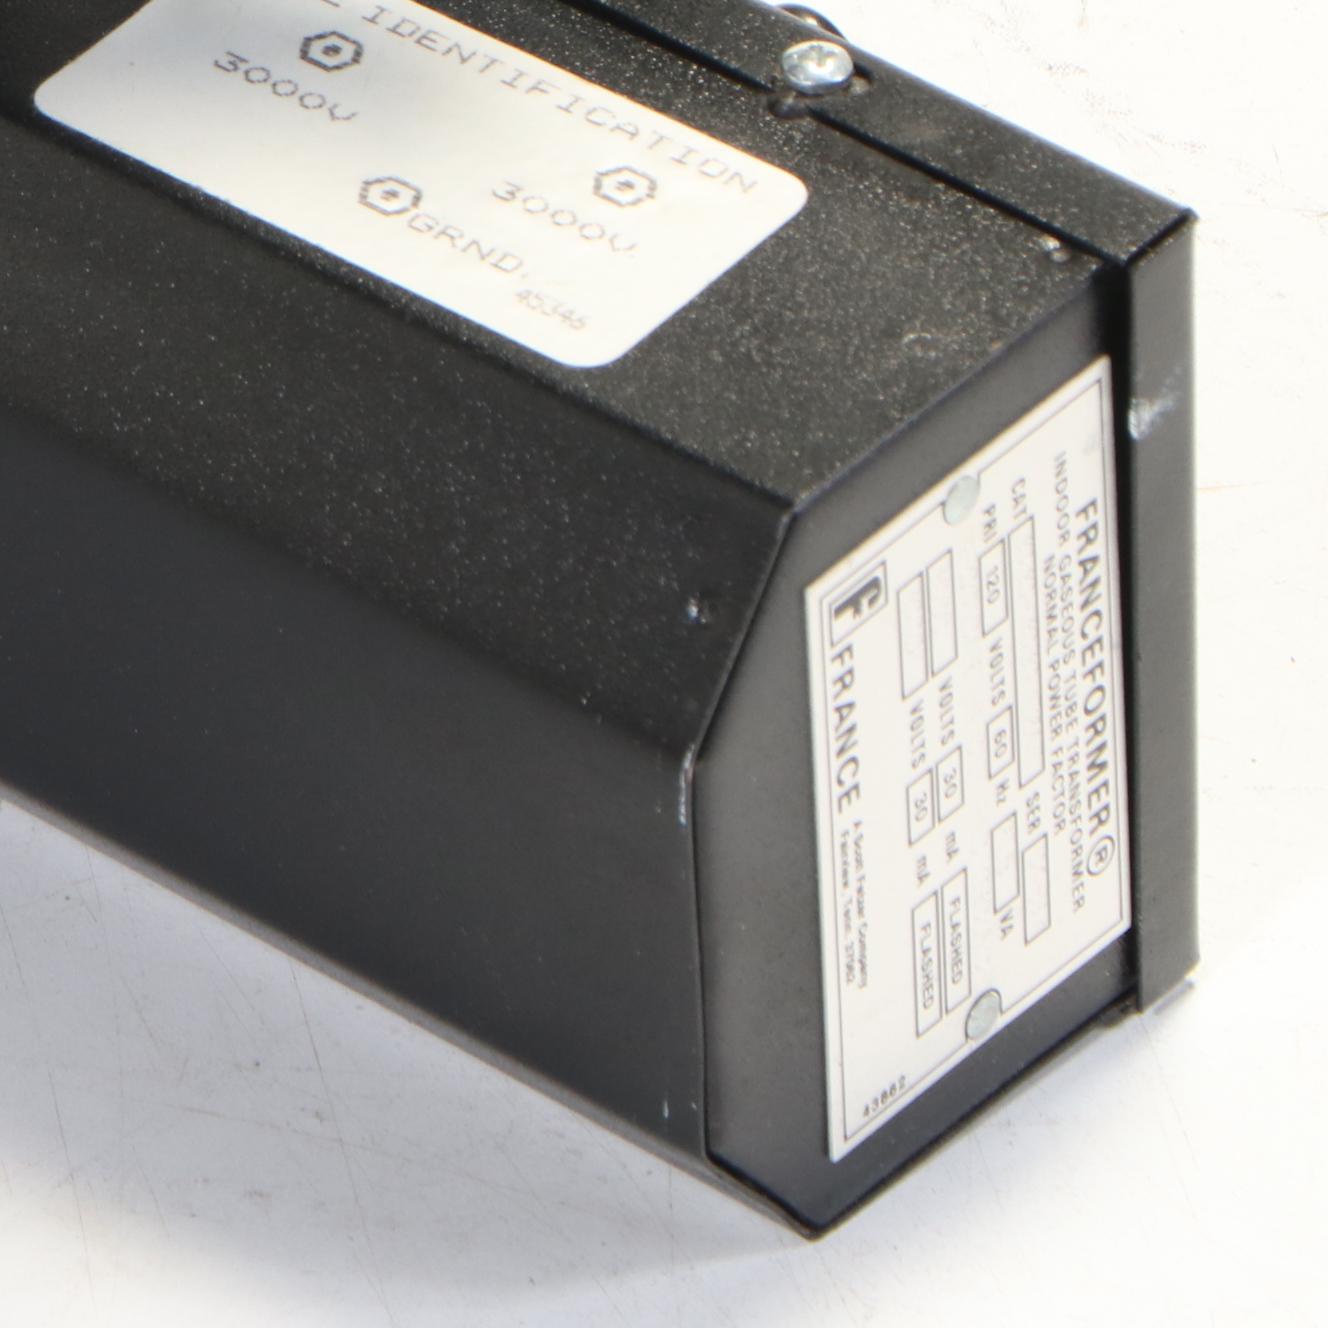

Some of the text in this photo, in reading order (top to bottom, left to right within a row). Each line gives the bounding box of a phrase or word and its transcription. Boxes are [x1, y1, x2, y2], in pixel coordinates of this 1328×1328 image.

[215, 52, 355, 123] 3000V
[361, 4, 758, 195] IDENTIFICATION
[408, 211, 530, 278] GRND.
[831, 647, 860, 810] FRANCE
[982, 501, 1013, 941] PRI 120 VOLTS 60 Hz VA
[1011, 476, 1040, 835] CAT SER
[1042, 555, 1066, 834] NORMAL POWER FACTOR
[1053, 452, 1085, 908] INDOOR GASEOUS TUBE TRANSFORMER
[855, 921, 870, 991] Company
[909, 700, 935, 1011] VOLTS 30 mA FLASHED
[938, 677, 964, 986] VOLTS 30 mA FLASHED
